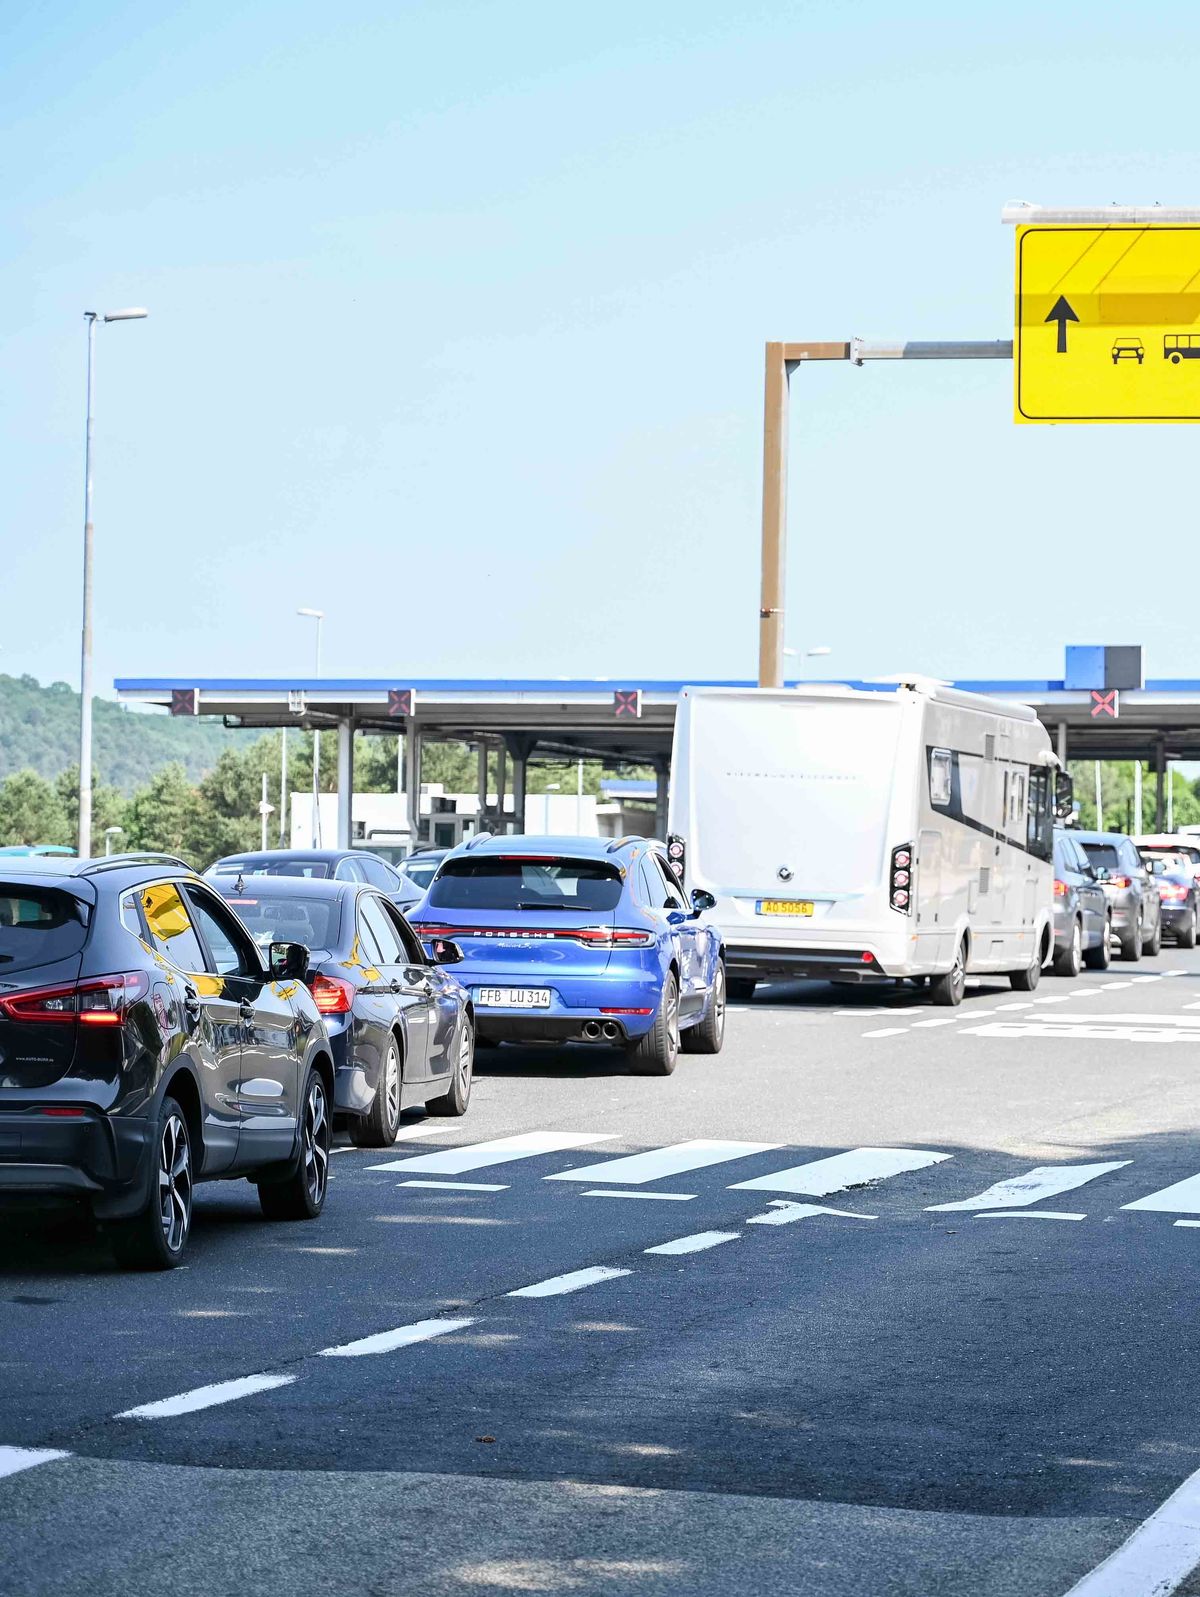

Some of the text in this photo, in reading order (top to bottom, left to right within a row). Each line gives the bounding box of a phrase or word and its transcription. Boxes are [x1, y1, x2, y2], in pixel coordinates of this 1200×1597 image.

[480, 989, 547, 1004] FFB LU 314
